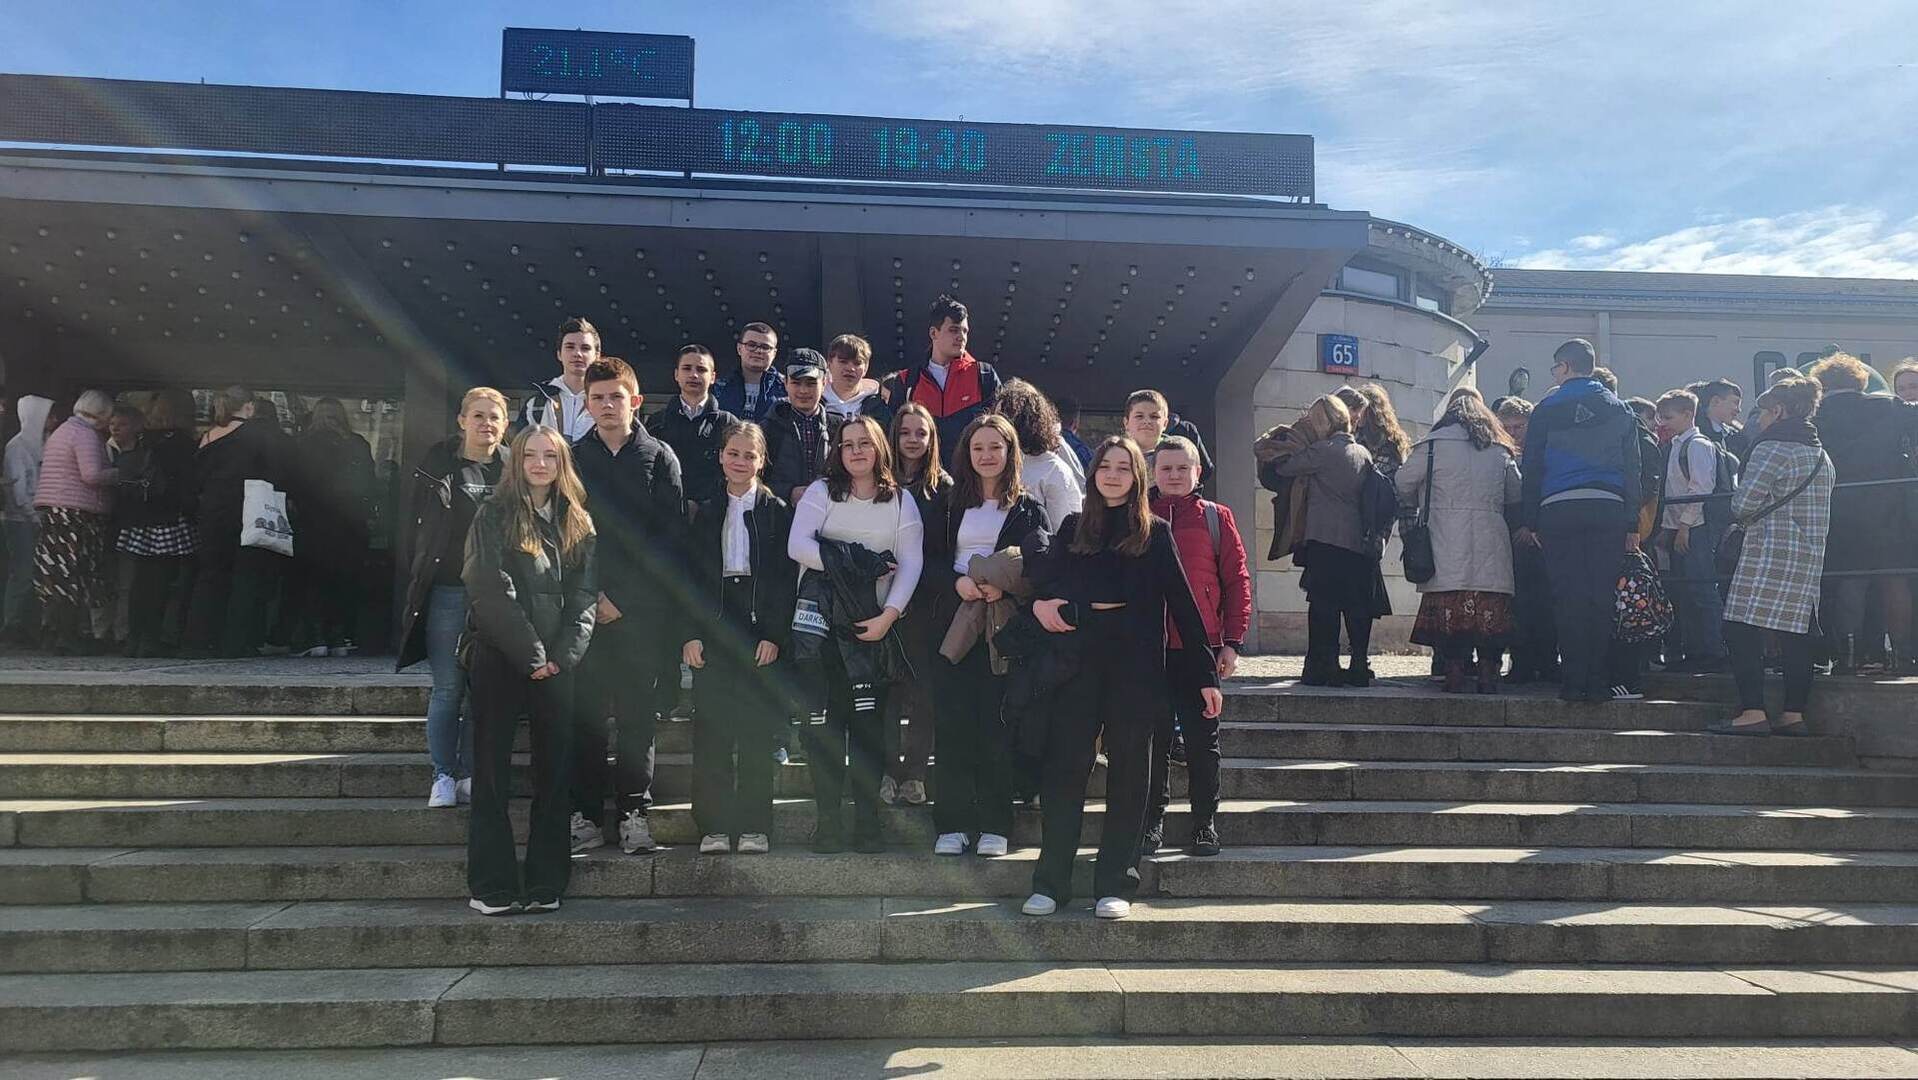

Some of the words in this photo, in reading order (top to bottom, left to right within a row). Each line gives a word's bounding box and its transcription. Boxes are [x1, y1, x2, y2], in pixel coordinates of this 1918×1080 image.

[717, 119, 832, 165] 12:00
[874, 126, 985, 172] 19:30
[1046, 133, 1200, 179] ZEMSTA
[1332, 343, 1353, 365] 65
